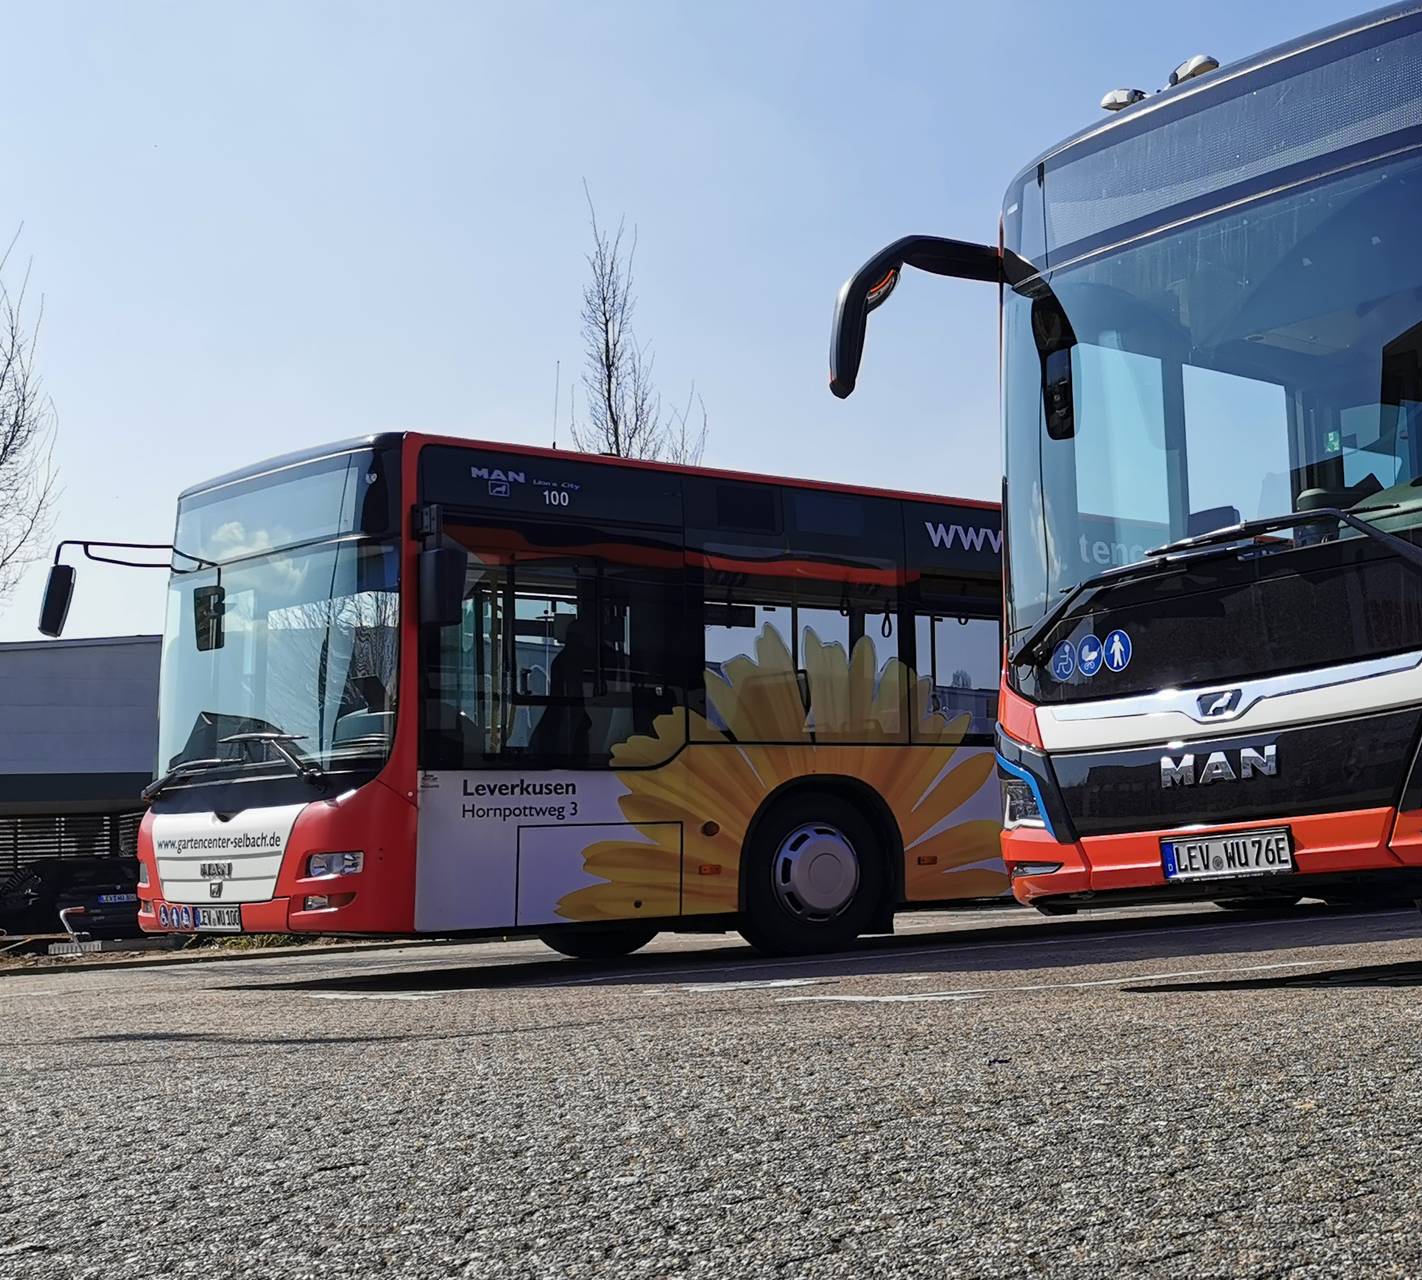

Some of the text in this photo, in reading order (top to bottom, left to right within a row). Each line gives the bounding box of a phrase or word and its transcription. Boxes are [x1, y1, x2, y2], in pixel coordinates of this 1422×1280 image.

[470, 466, 526, 483] MAN
[543, 489, 570, 507] 100
[1160, 744, 1278, 788] MAN
[462, 778, 577, 797] Leverkusen
[461, 801, 579, 822] Hornpottweg 3
[1174, 843, 1210, 873] LEV
[1223, 840, 1250, 868] WU
[1251, 836, 1290, 866] 76E
